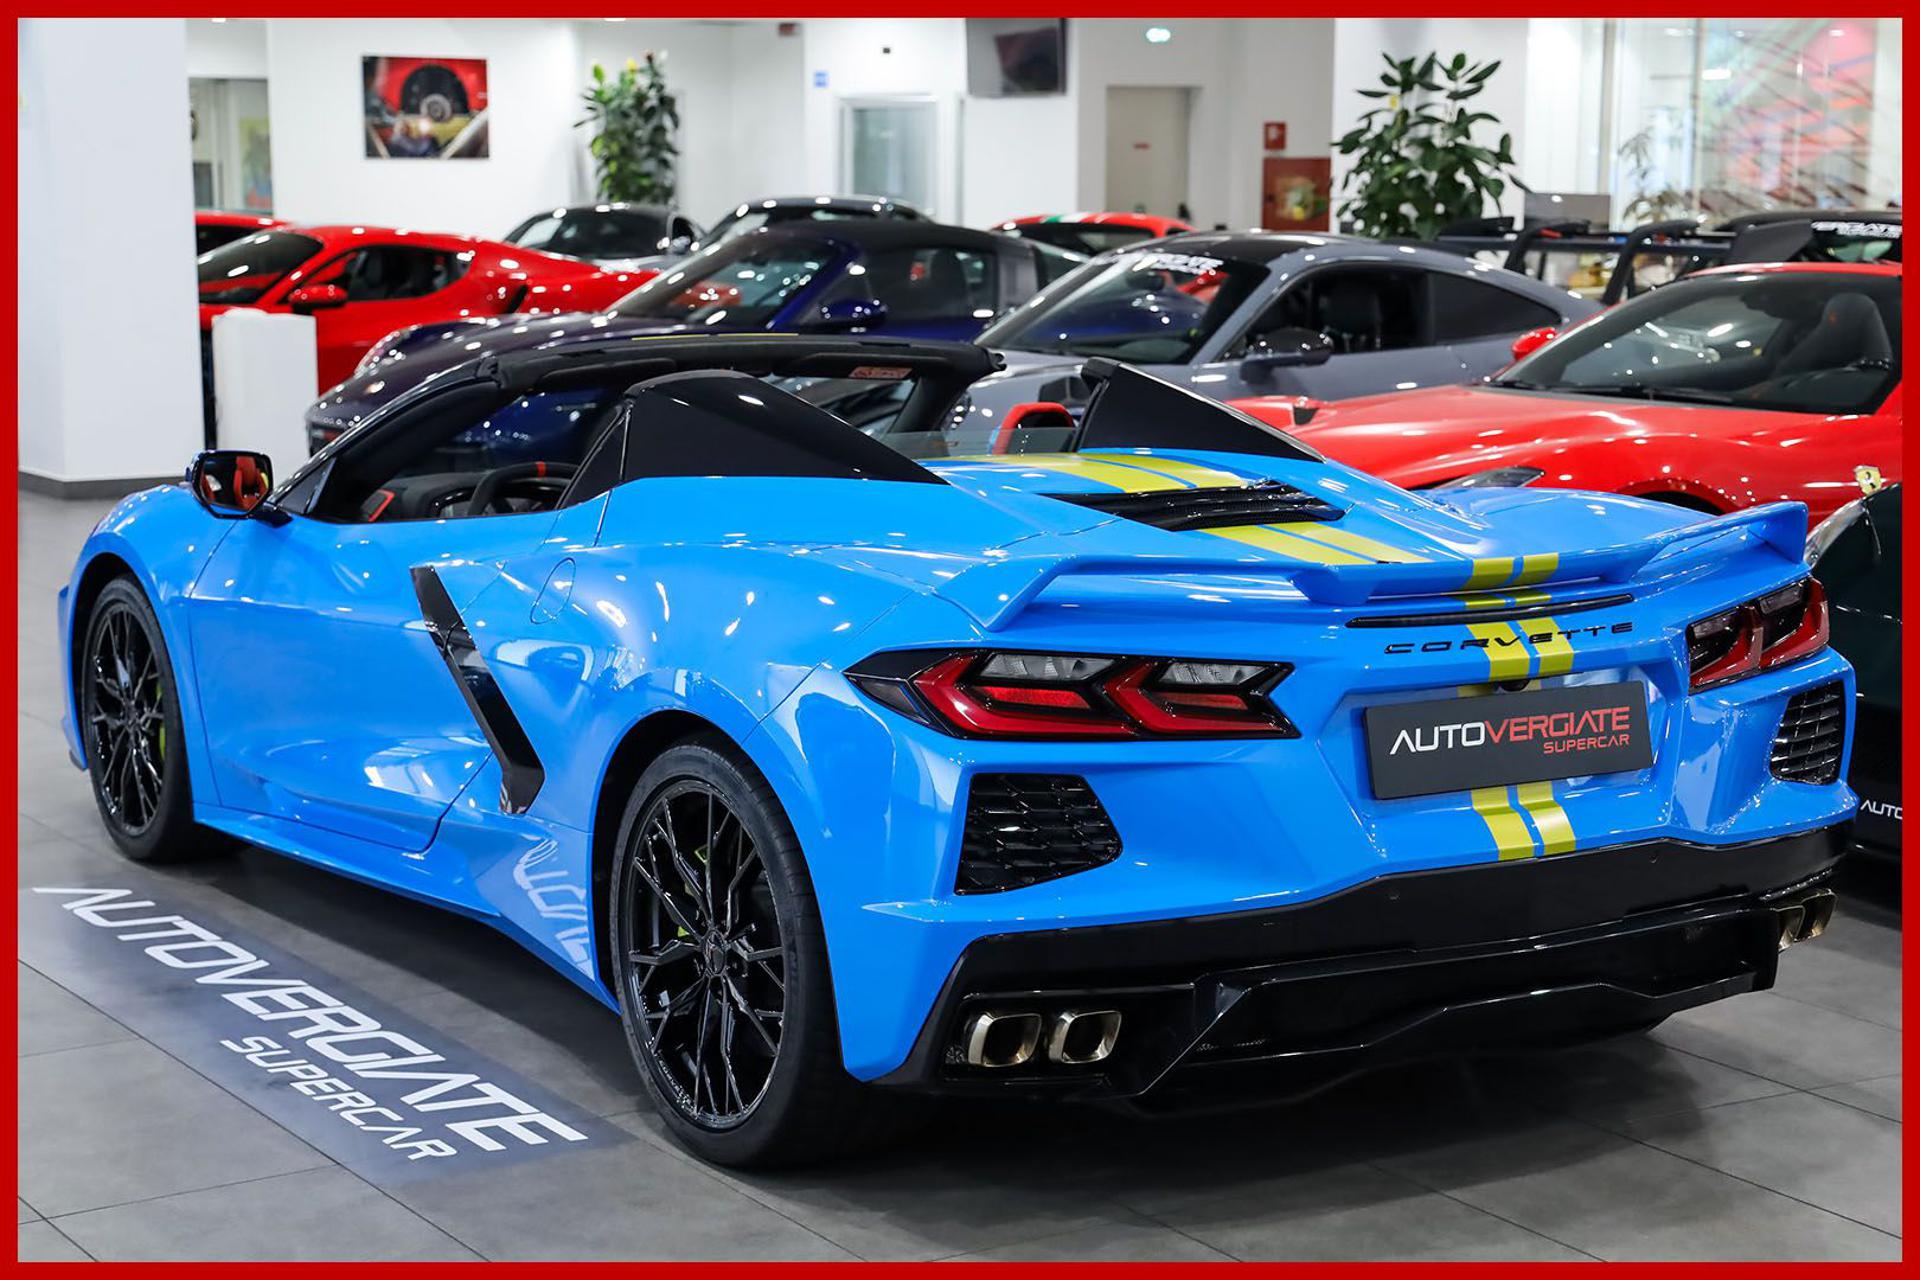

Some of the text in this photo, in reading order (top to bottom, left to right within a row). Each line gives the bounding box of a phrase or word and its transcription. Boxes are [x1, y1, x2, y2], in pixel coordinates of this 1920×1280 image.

[1384, 622, 1633, 654] CORVETTE
[1389, 706, 1630, 755] AUTOVERGIATE
[1543, 734, 1630, 754] SUPERCAR
[32, 887, 589, 1151] AUTOVERGIATE
[220, 1036, 457, 1160] SUPERCAR
